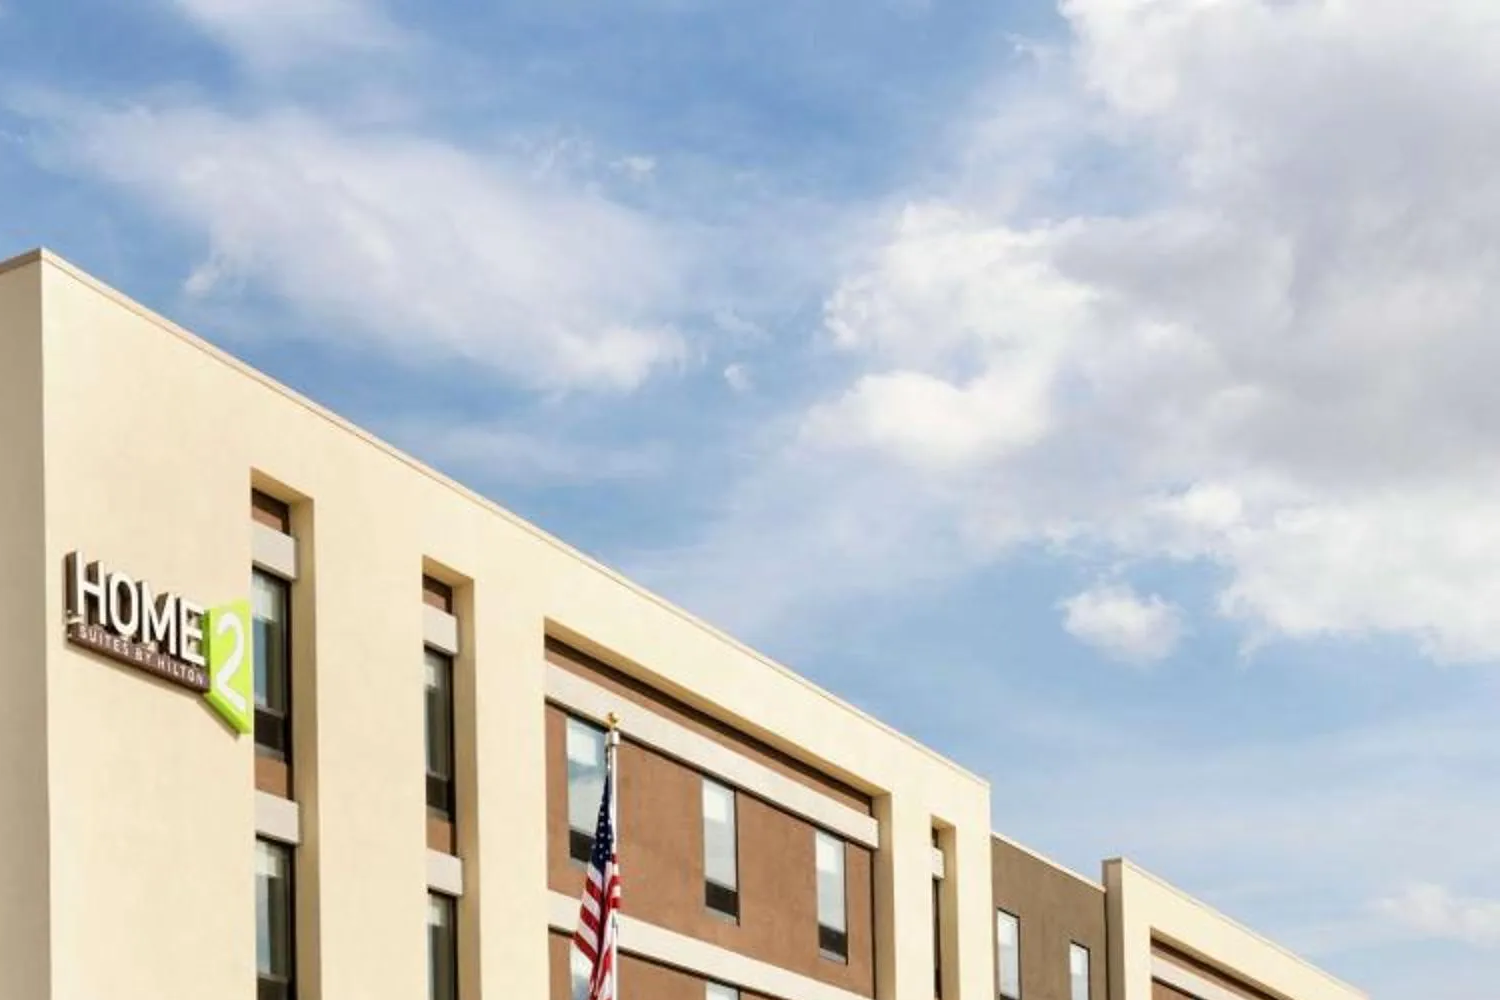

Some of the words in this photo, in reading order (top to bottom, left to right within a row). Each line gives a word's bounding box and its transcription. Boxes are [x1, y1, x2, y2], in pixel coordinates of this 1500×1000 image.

[76, 549, 207, 668] HOME
[216, 611, 247, 713] 2
[79, 625, 130, 657] SUITES
[134, 646, 152, 664] BY
[157, 655, 206, 684] HILTON
